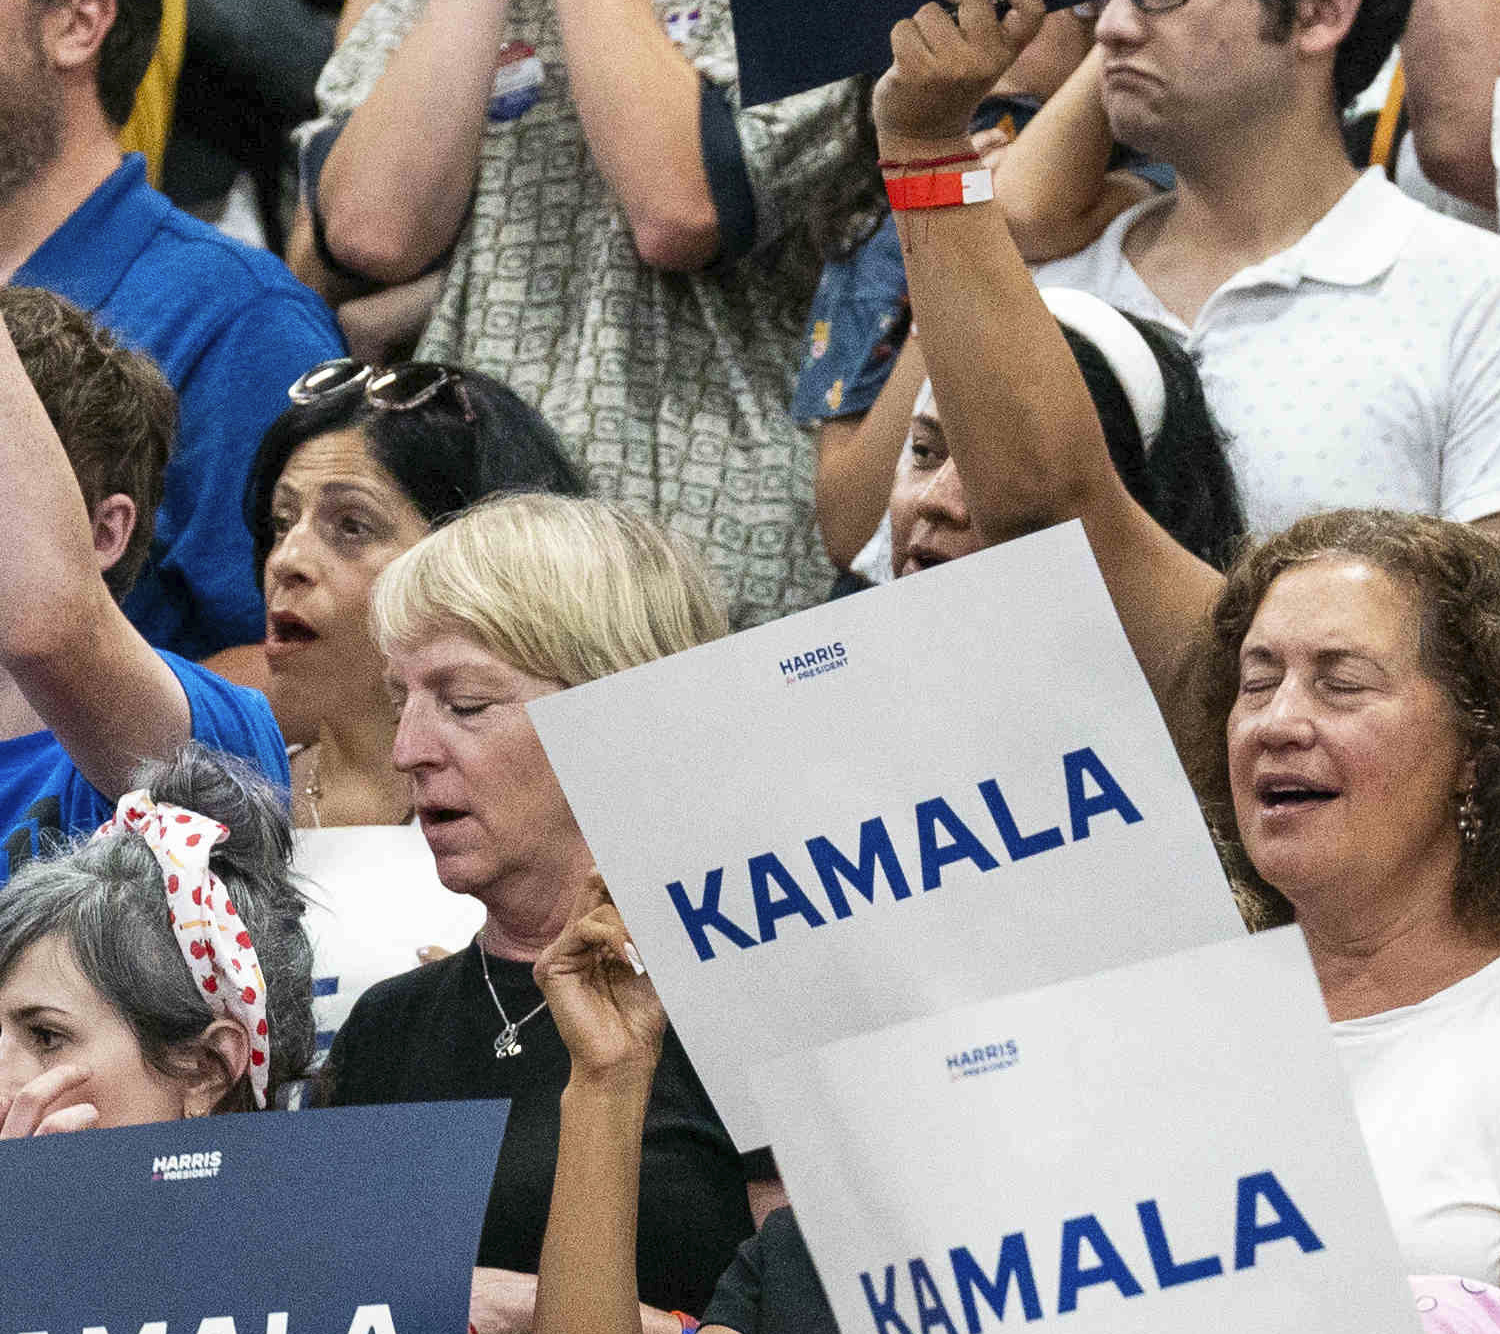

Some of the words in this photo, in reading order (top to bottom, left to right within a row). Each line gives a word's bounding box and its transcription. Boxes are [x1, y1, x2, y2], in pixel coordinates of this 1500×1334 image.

[779, 642, 845, 675] HARRIS
[797, 658, 848, 681] PRESIDENT
[664, 746, 1143, 962] KAMALA
[152, 1151, 222, 1173] HARRIS
[163, 1167, 221, 1181] PRESIDENT
